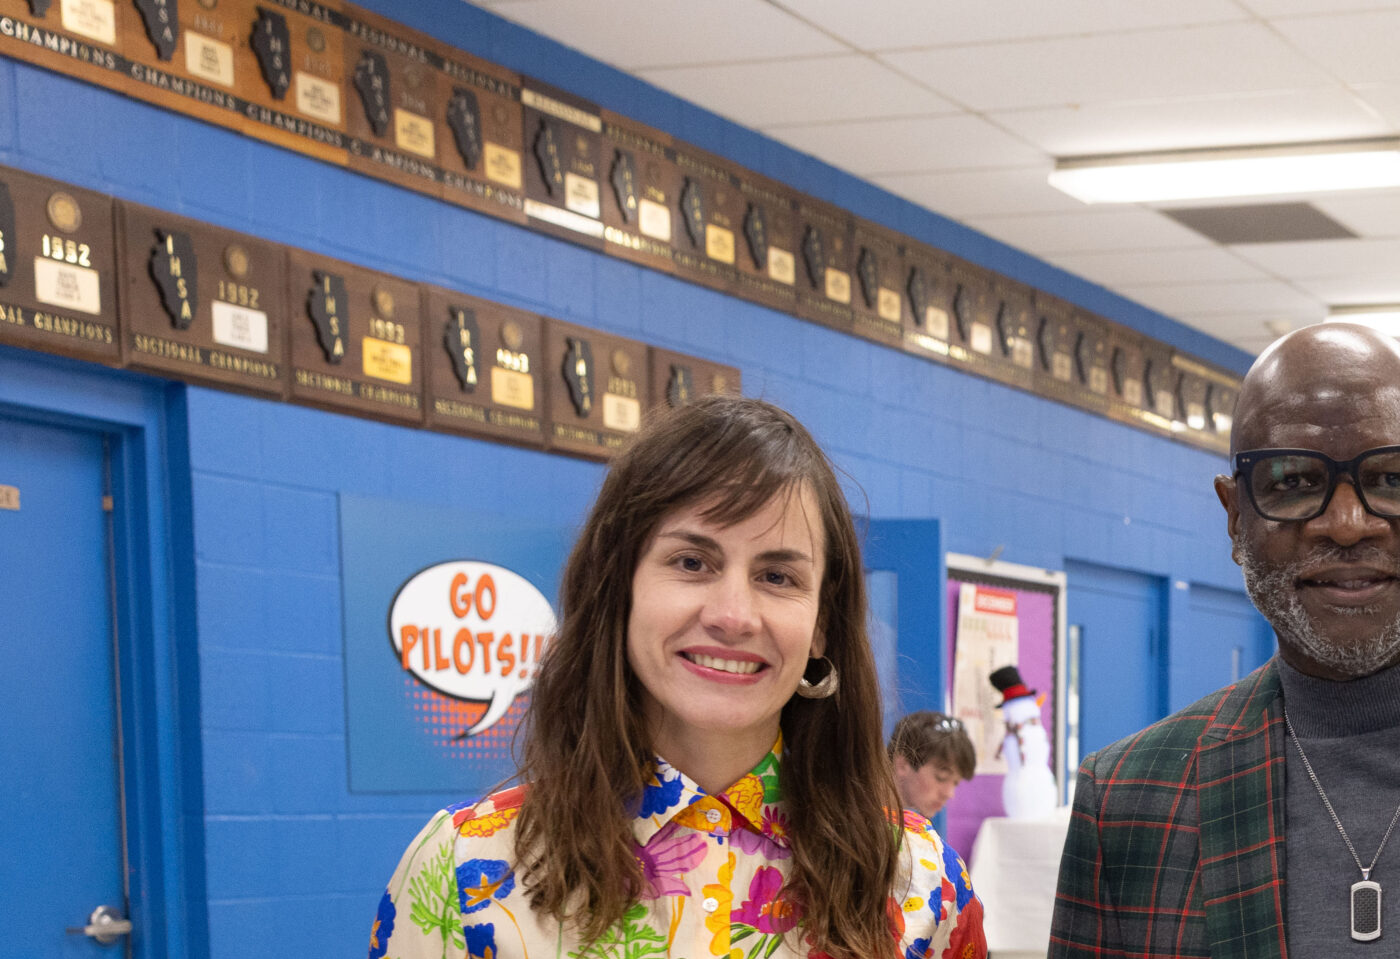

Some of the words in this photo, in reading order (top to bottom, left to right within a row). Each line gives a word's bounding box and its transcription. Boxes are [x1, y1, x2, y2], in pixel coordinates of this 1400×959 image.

[0, 17, 115, 70] CHAMPIONS
[131, 63, 235, 110] CHAMPIONS
[247, 104, 342, 147] CHAMPIONS
[167, 234, 192, 320] IHSA
[34, 312, 112, 344] CHAMPIONS
[324, 276, 344, 357] IHSA
[210, 352, 276, 379] CHAMPIONS
[450, 572, 496, 620] GO
